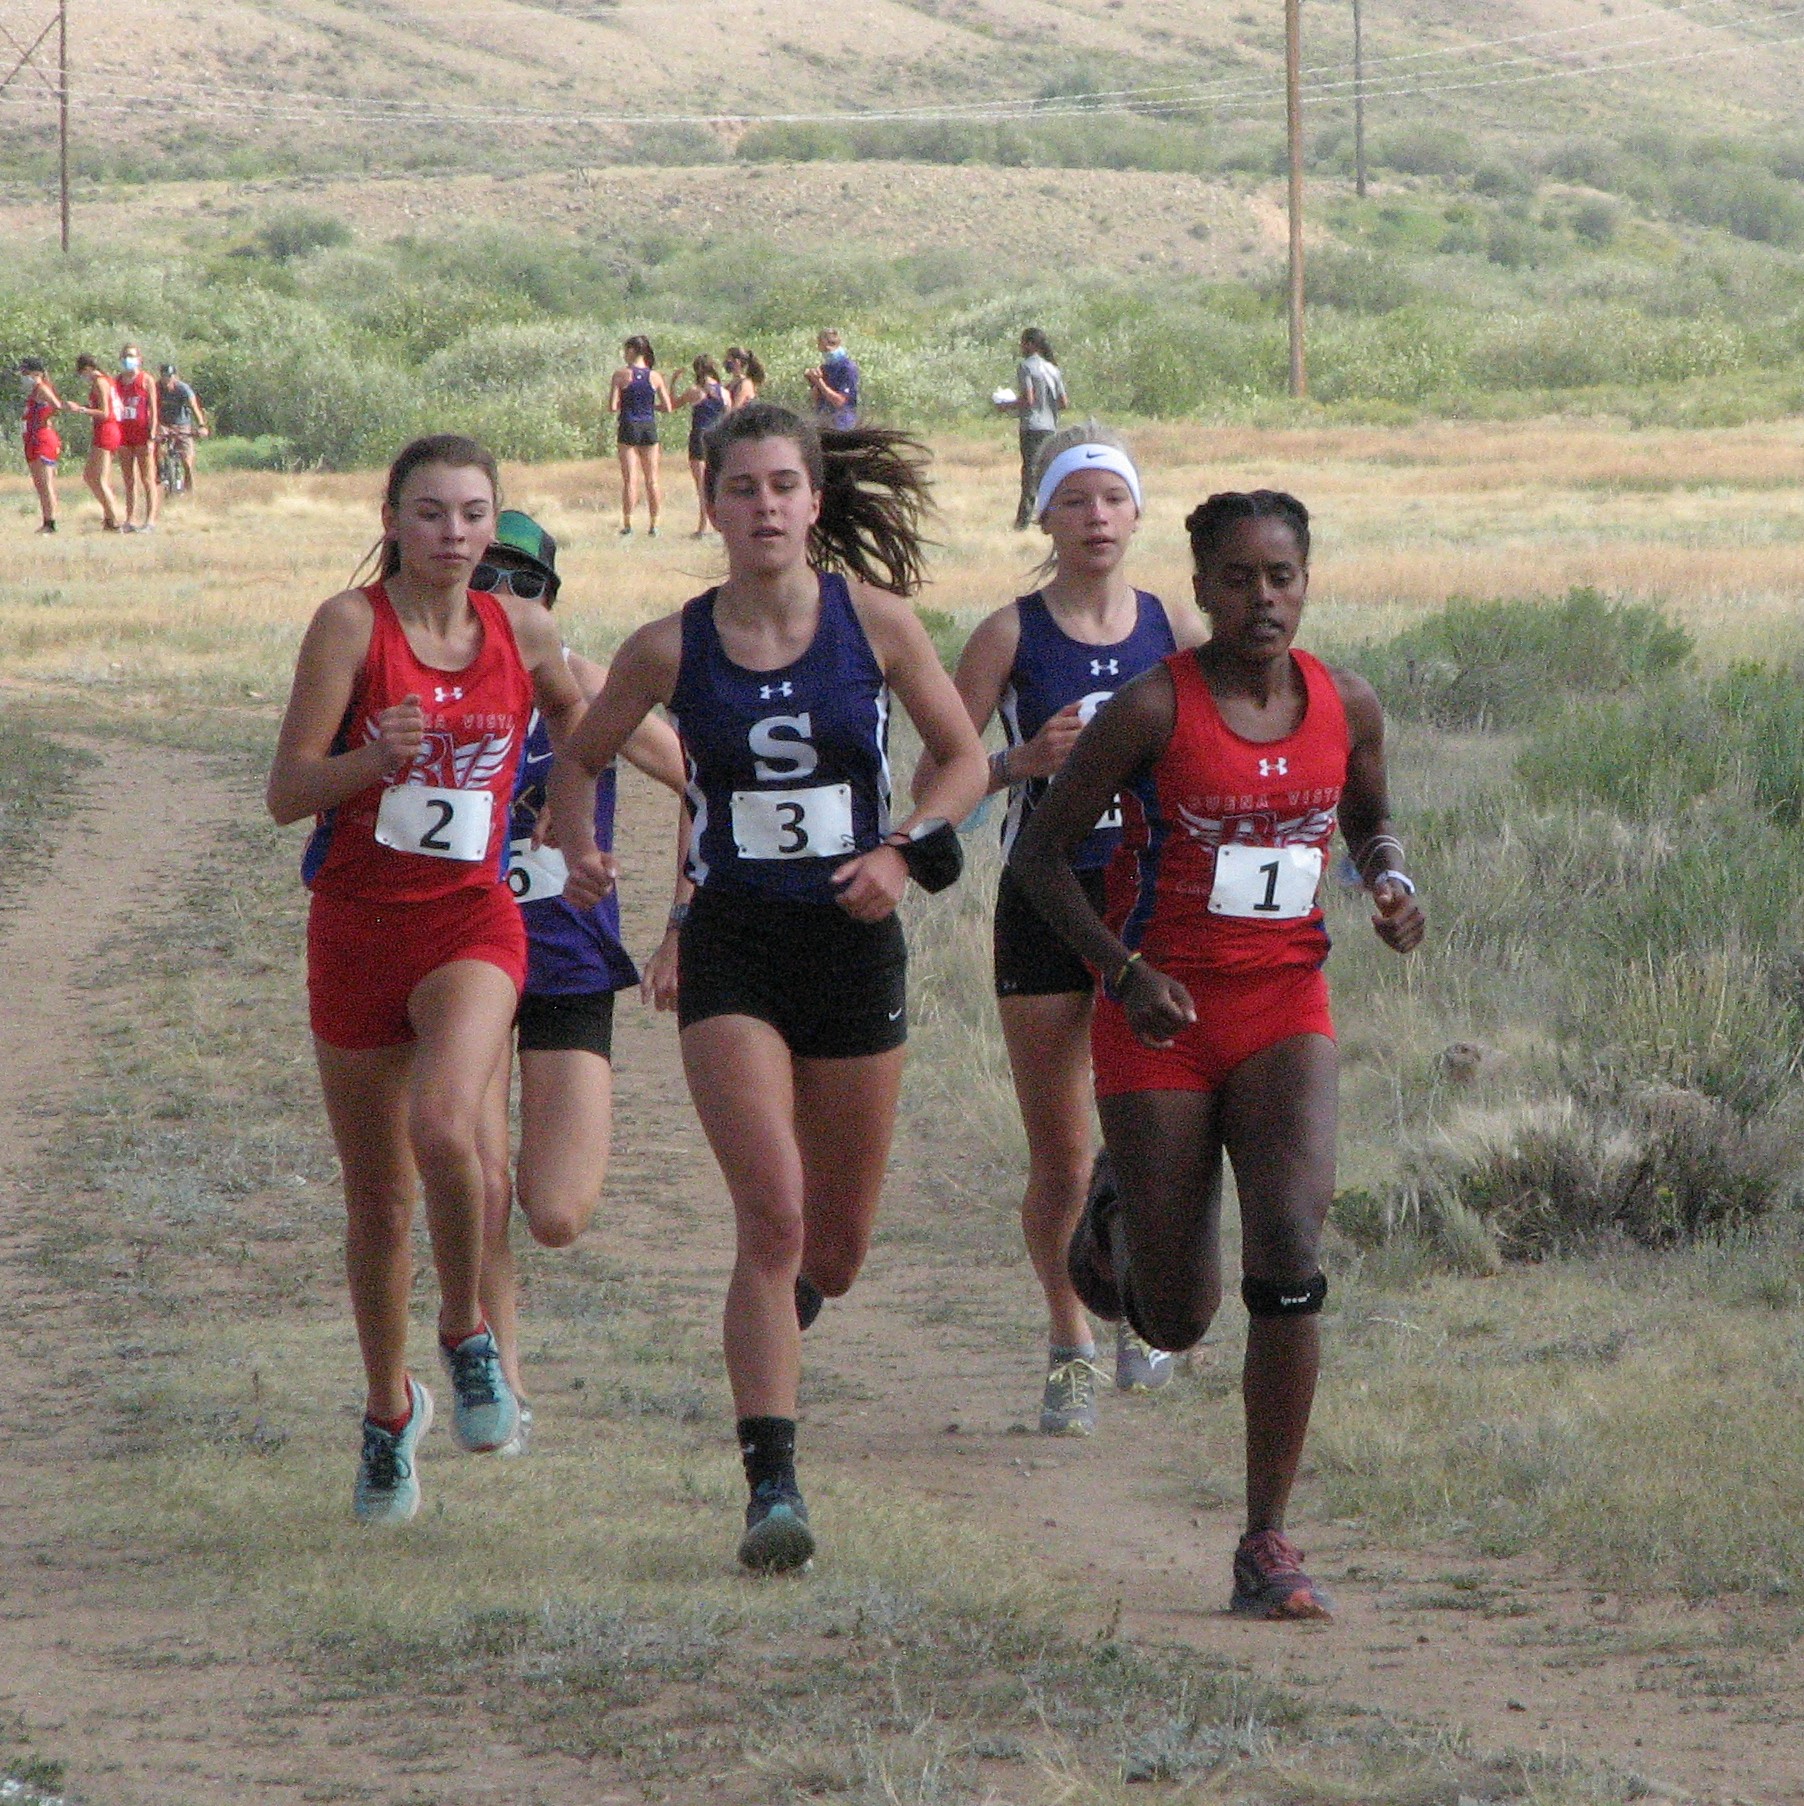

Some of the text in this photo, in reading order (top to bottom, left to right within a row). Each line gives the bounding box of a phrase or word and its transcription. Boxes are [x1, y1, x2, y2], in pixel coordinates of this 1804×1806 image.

[748, 712, 818, 782] S
[420, 800, 454, 851] 2
[776, 802, 809, 854] 3
[1253, 860, 1281, 912] 1
